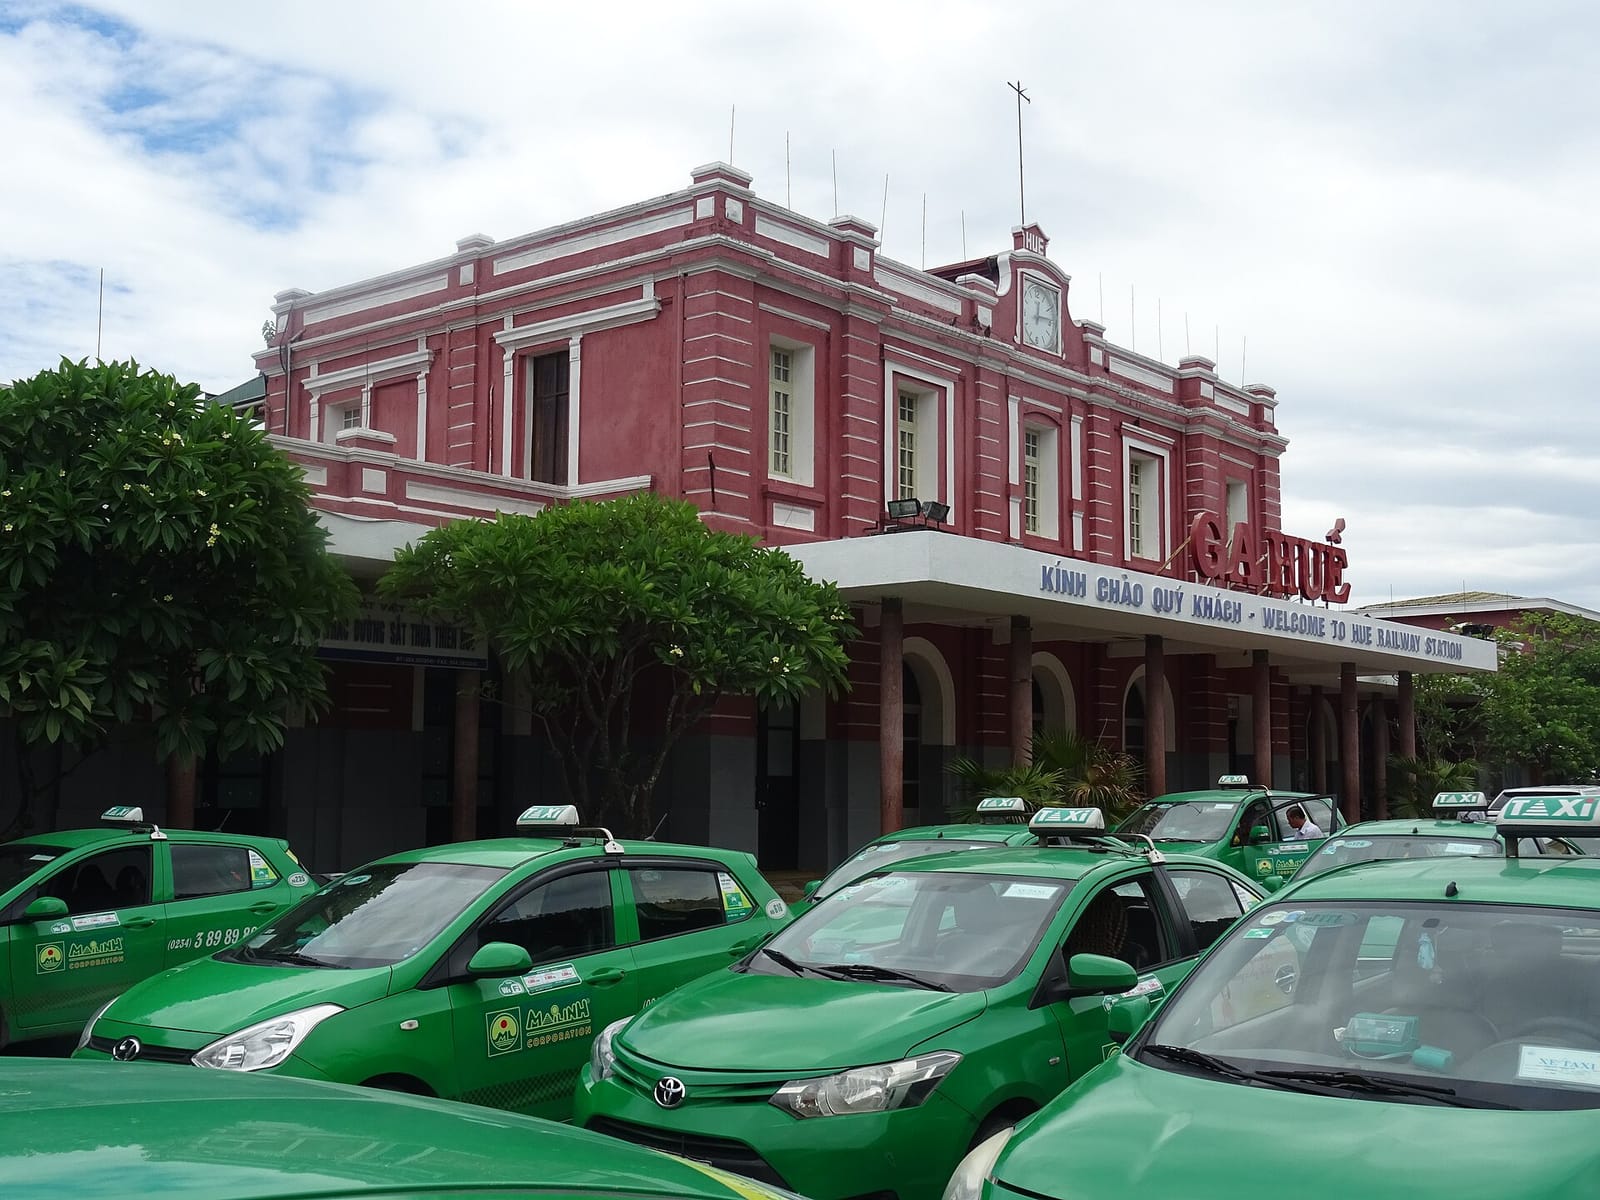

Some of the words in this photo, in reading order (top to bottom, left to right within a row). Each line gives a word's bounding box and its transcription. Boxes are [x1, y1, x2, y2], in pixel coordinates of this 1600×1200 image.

[1190, 513, 1262, 585] GA
[1041, 561, 1086, 598] KÍNH
[1152, 585, 1184, 614] QUÝ
[1192, 592, 1242, 624] KHÁCH
[1263, 607, 1326, 638] WELCOME
[1330, 619, 1346, 641] TO
[1351, 623, 1372, 645] HUE
[1376, 628, 1421, 654] RAILWAY
[1424, 636, 1462, 661] STATION
[194, 932, 204, 949] 3
[205, 930, 222, 947] 89
[224, 929, 240, 945] 89
[69, 956, 124, 969] CORPORATION
[526, 1026, 592, 1049] CORPORATION
